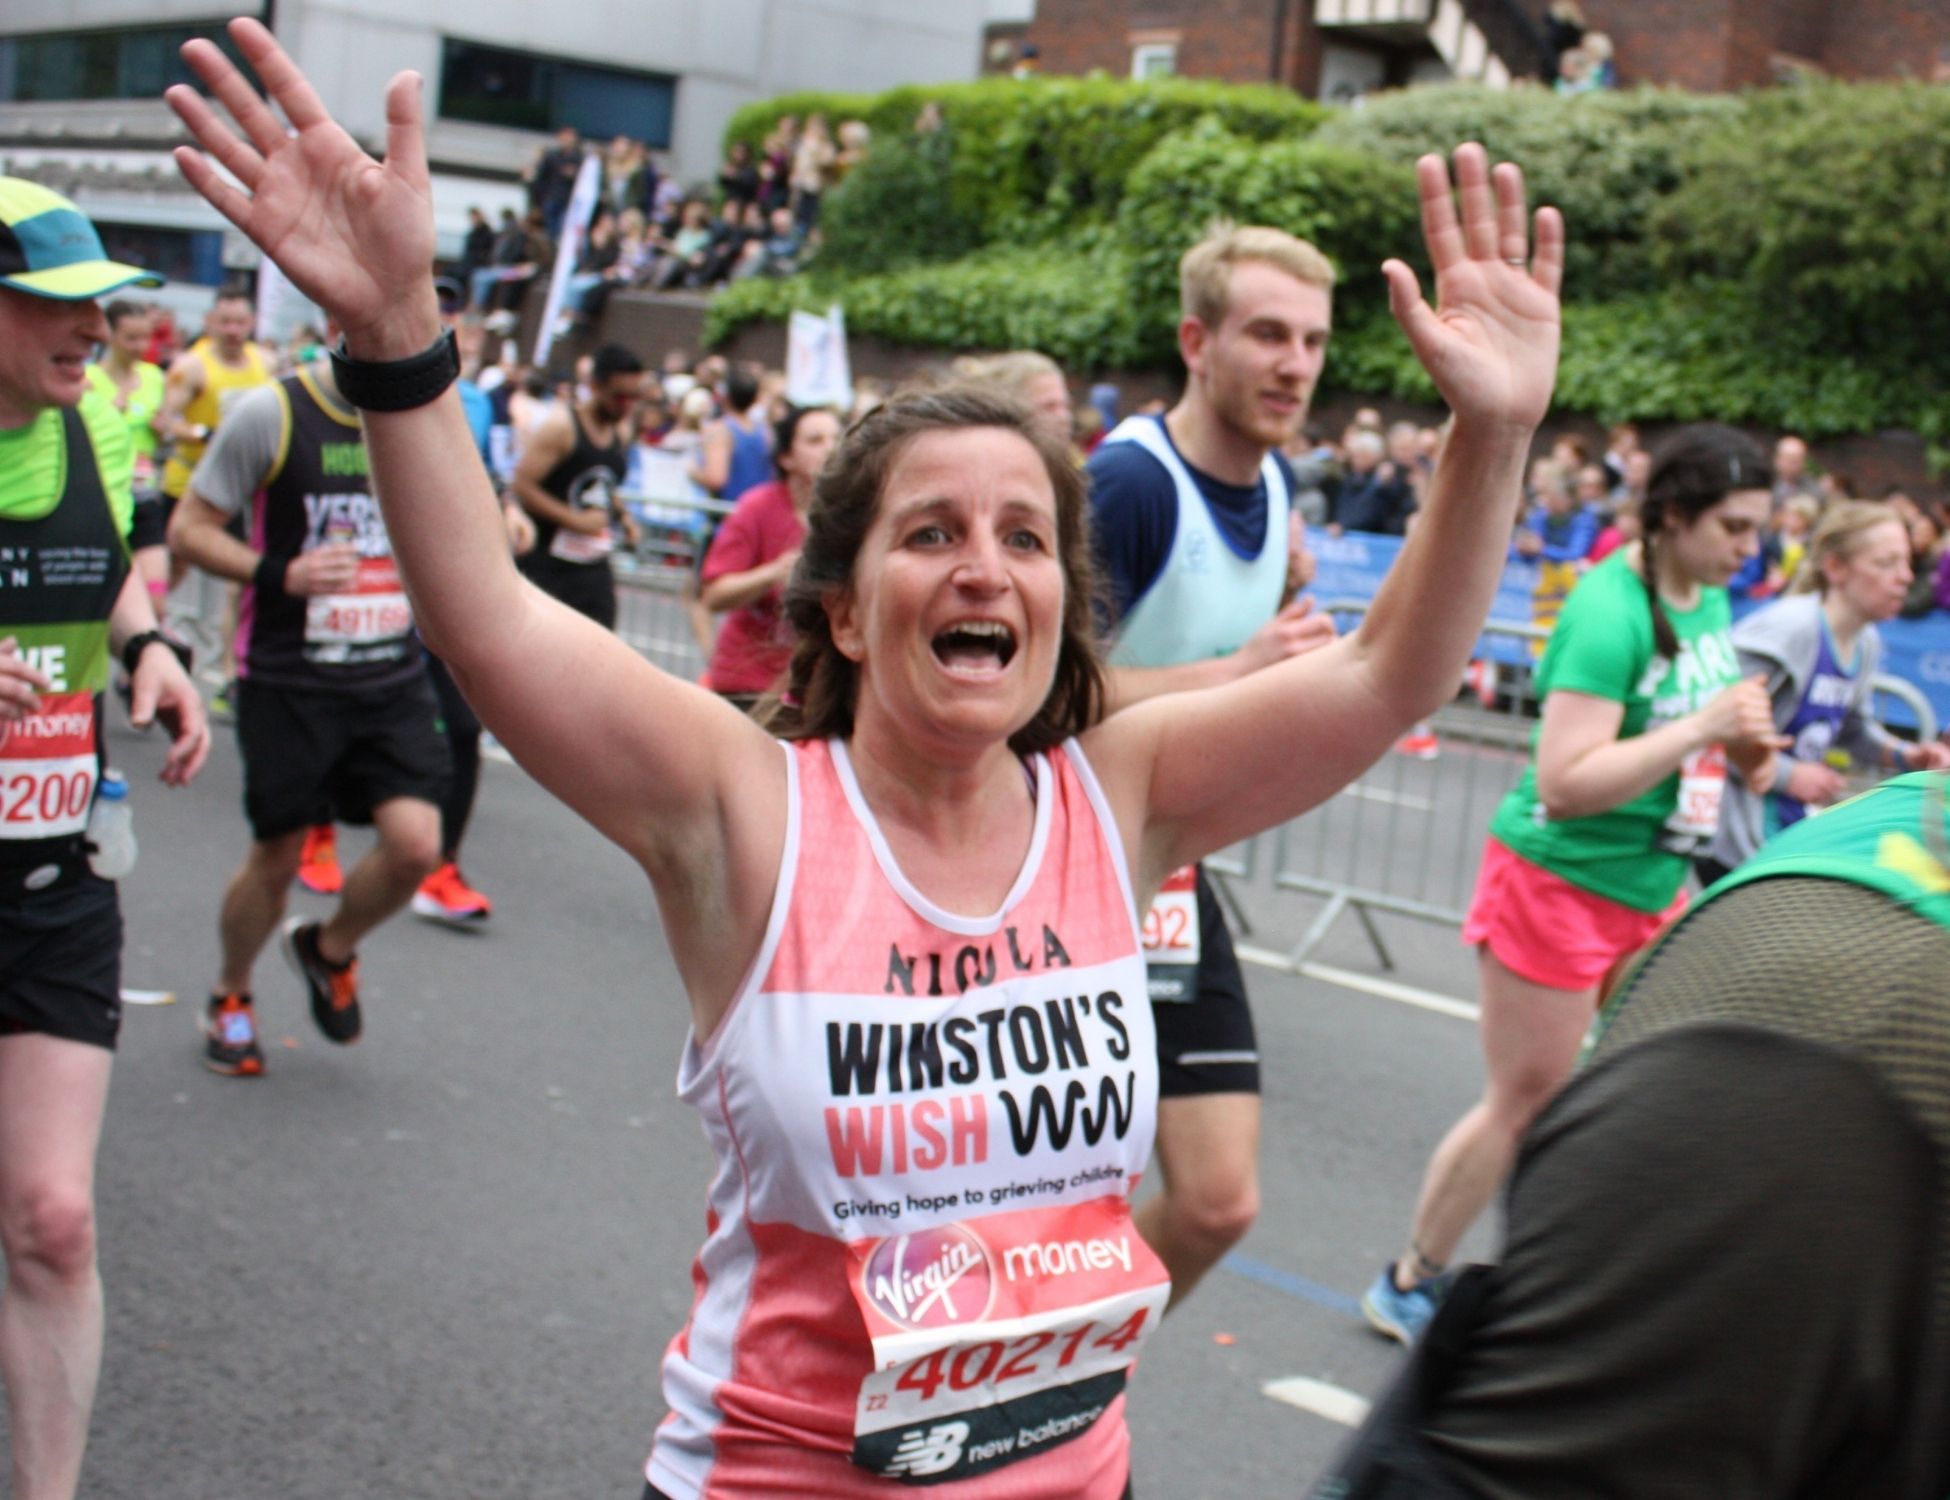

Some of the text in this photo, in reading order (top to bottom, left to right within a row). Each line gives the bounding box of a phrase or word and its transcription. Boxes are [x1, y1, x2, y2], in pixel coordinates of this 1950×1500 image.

[14, 711, 93, 744] money
[0, 771, 91, 823] 200
[885, 924, 1071, 996] NICOLA
[826, 990, 1132, 1096] WINSTON'S
[824, 1093, 988, 1178] WISH
[833, 1200, 901, 1219] Giving
[906, 1193, 958, 1213] hope
[964, 1189, 984, 1204] to
[989, 1176, 1066, 1205] grieving
[874, 1234, 1133, 1323] Virgin money
[895, 1306, 1149, 1400] 40214
[968, 1436, 1015, 1464] new
